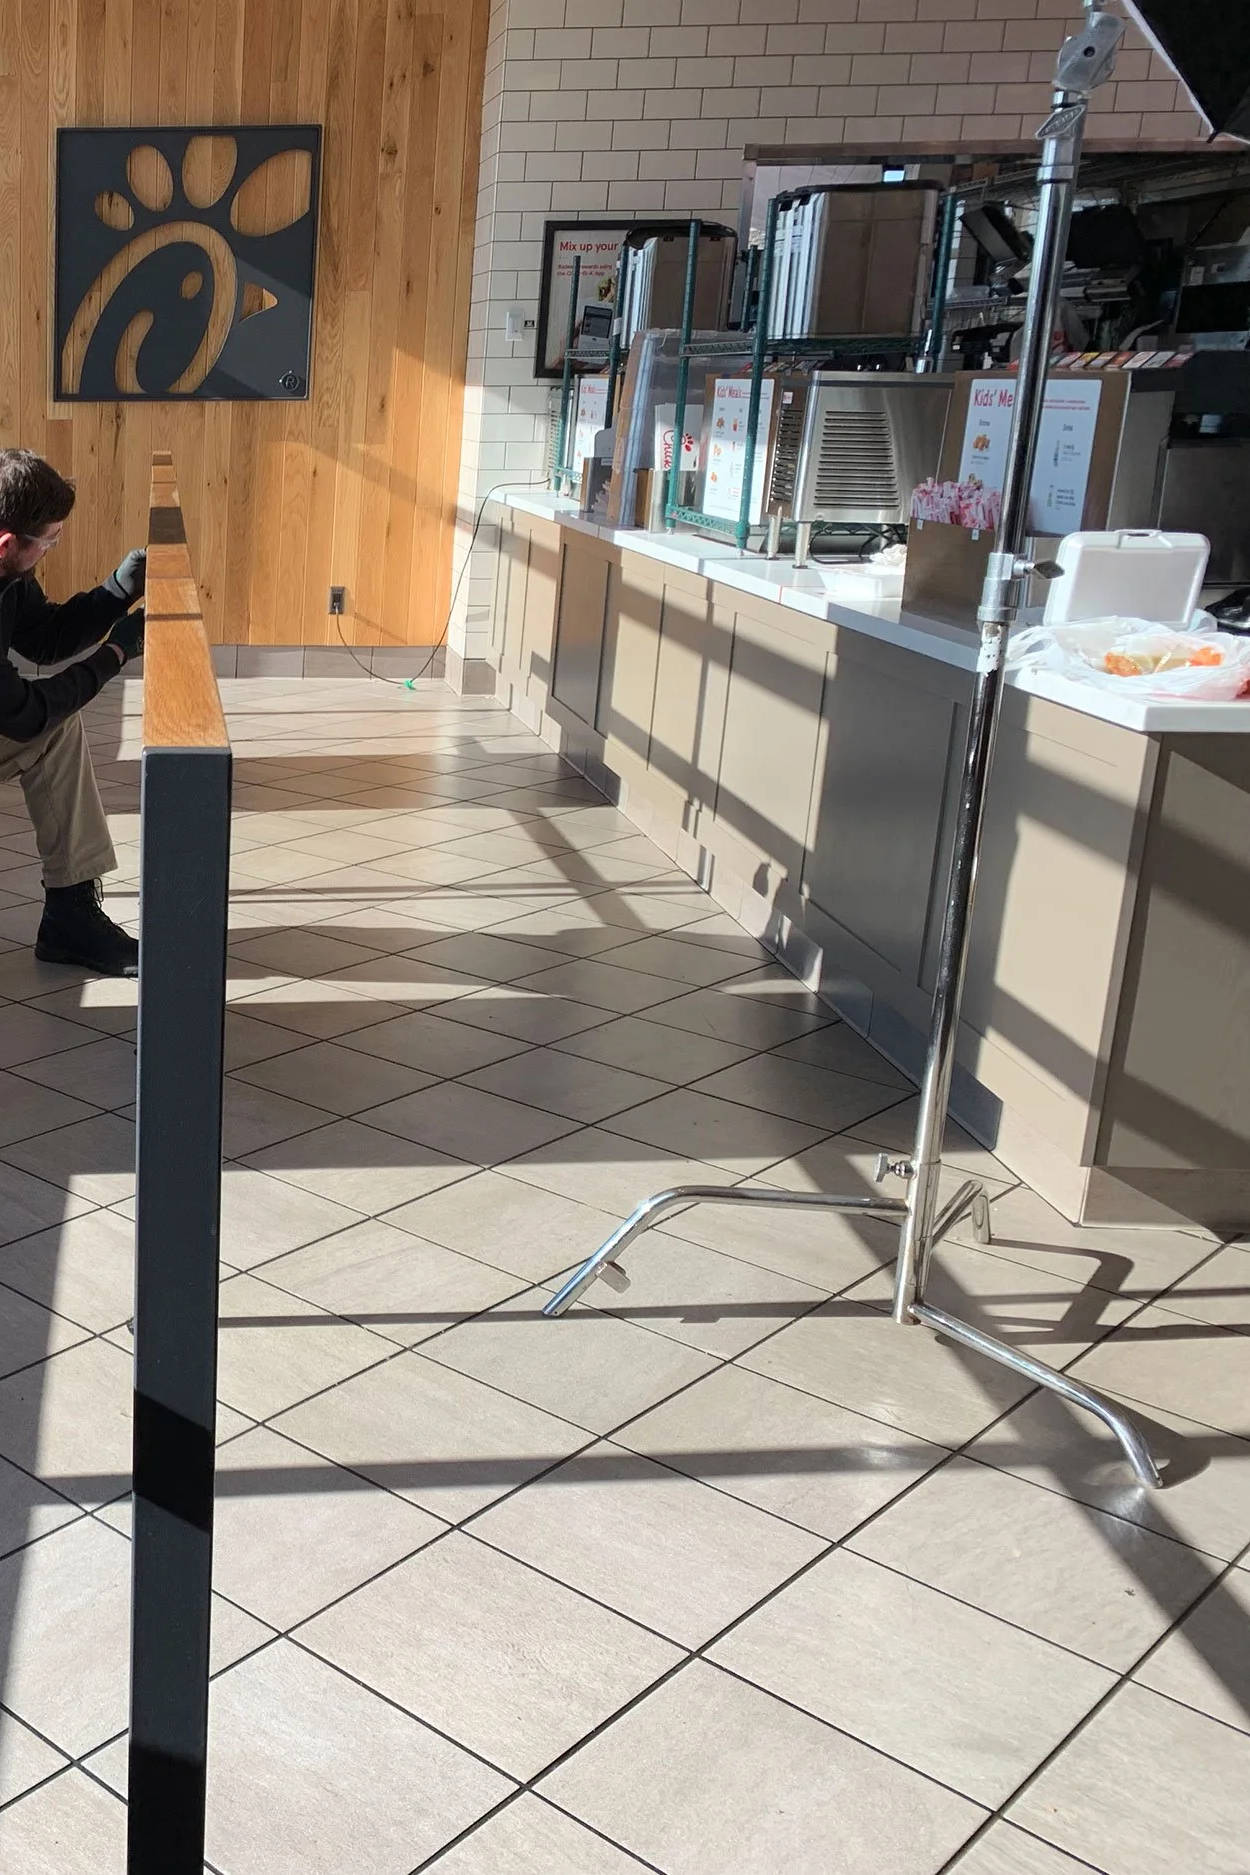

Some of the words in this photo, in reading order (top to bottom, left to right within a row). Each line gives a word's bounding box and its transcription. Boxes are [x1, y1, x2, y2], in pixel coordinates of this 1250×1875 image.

[559, 241, 577, 251] Mix
[579, 244, 593, 253] up
[595, 244, 618, 253] your
[973, 388, 997, 407] Kids'
